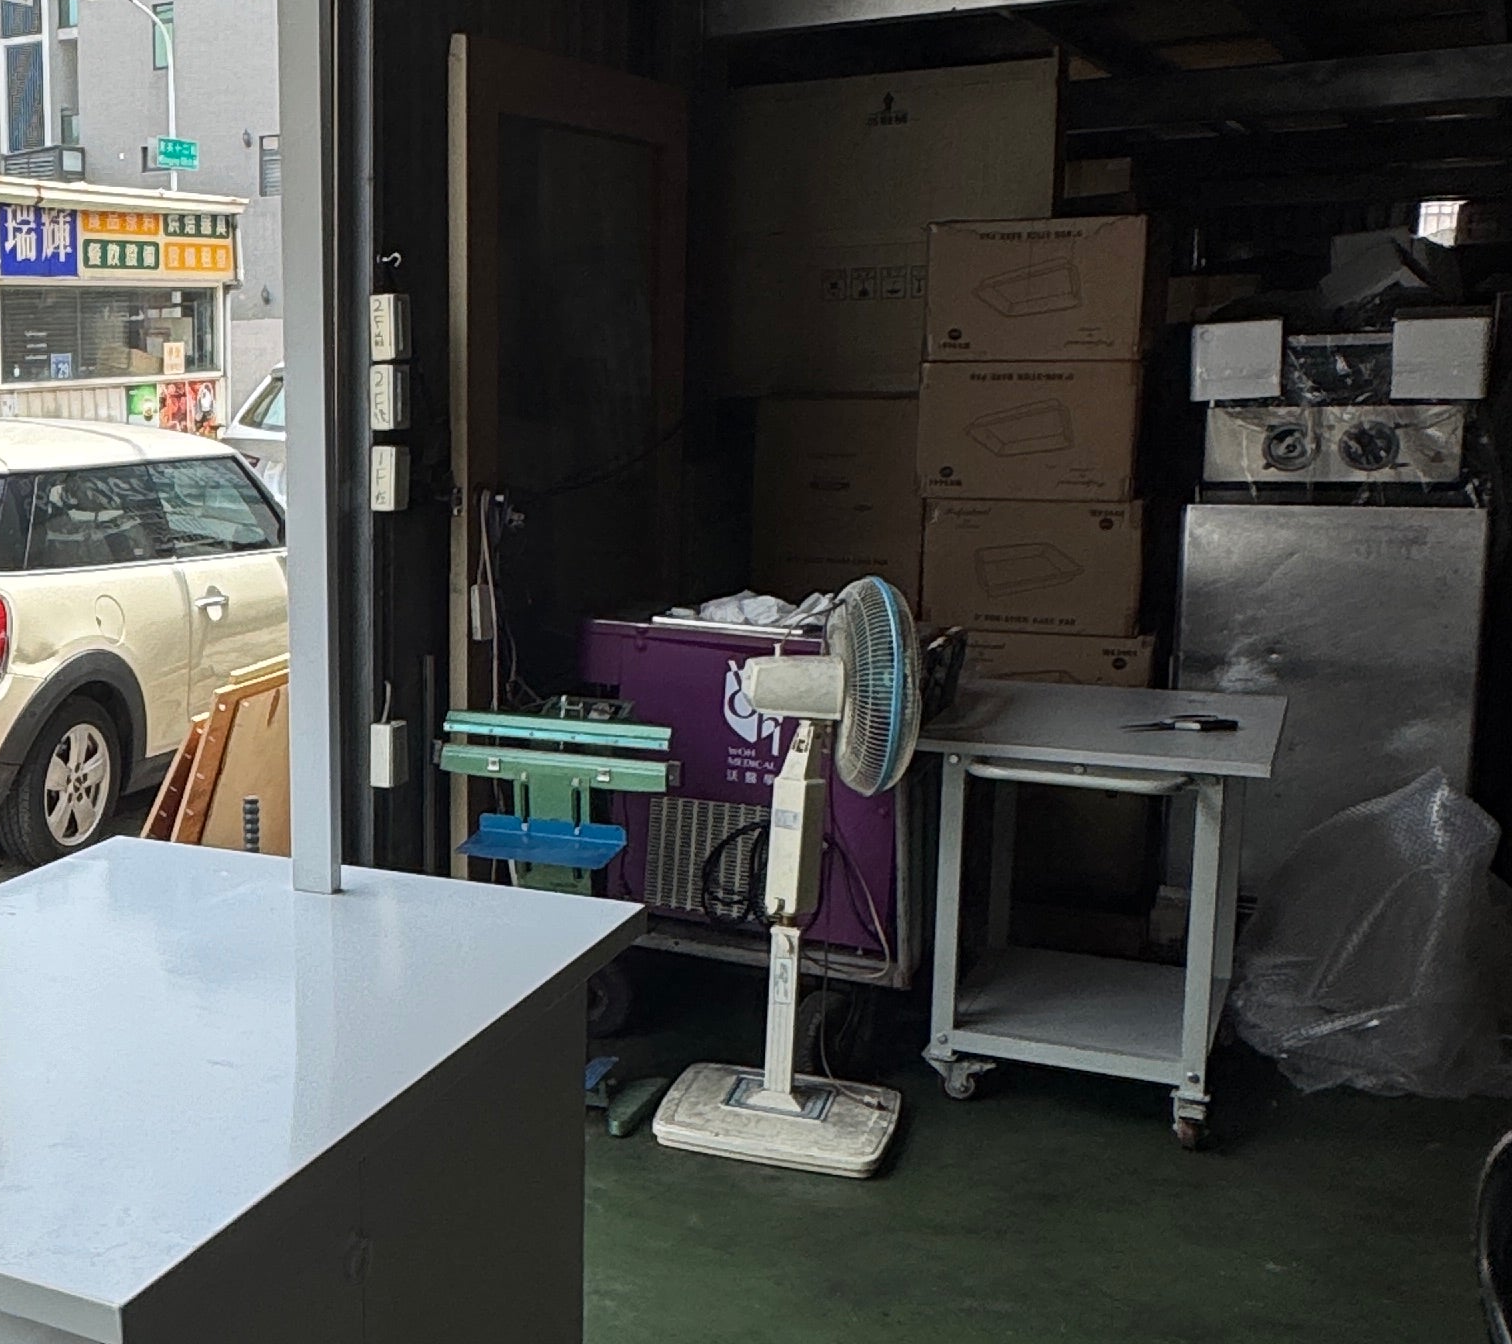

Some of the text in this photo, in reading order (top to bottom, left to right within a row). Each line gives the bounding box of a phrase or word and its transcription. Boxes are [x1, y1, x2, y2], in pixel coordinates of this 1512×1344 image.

[4, 205, 72, 262] 瑞輝
[728, 746, 756, 757] WOH
[728, 758, 775, 769] MEDICAL
